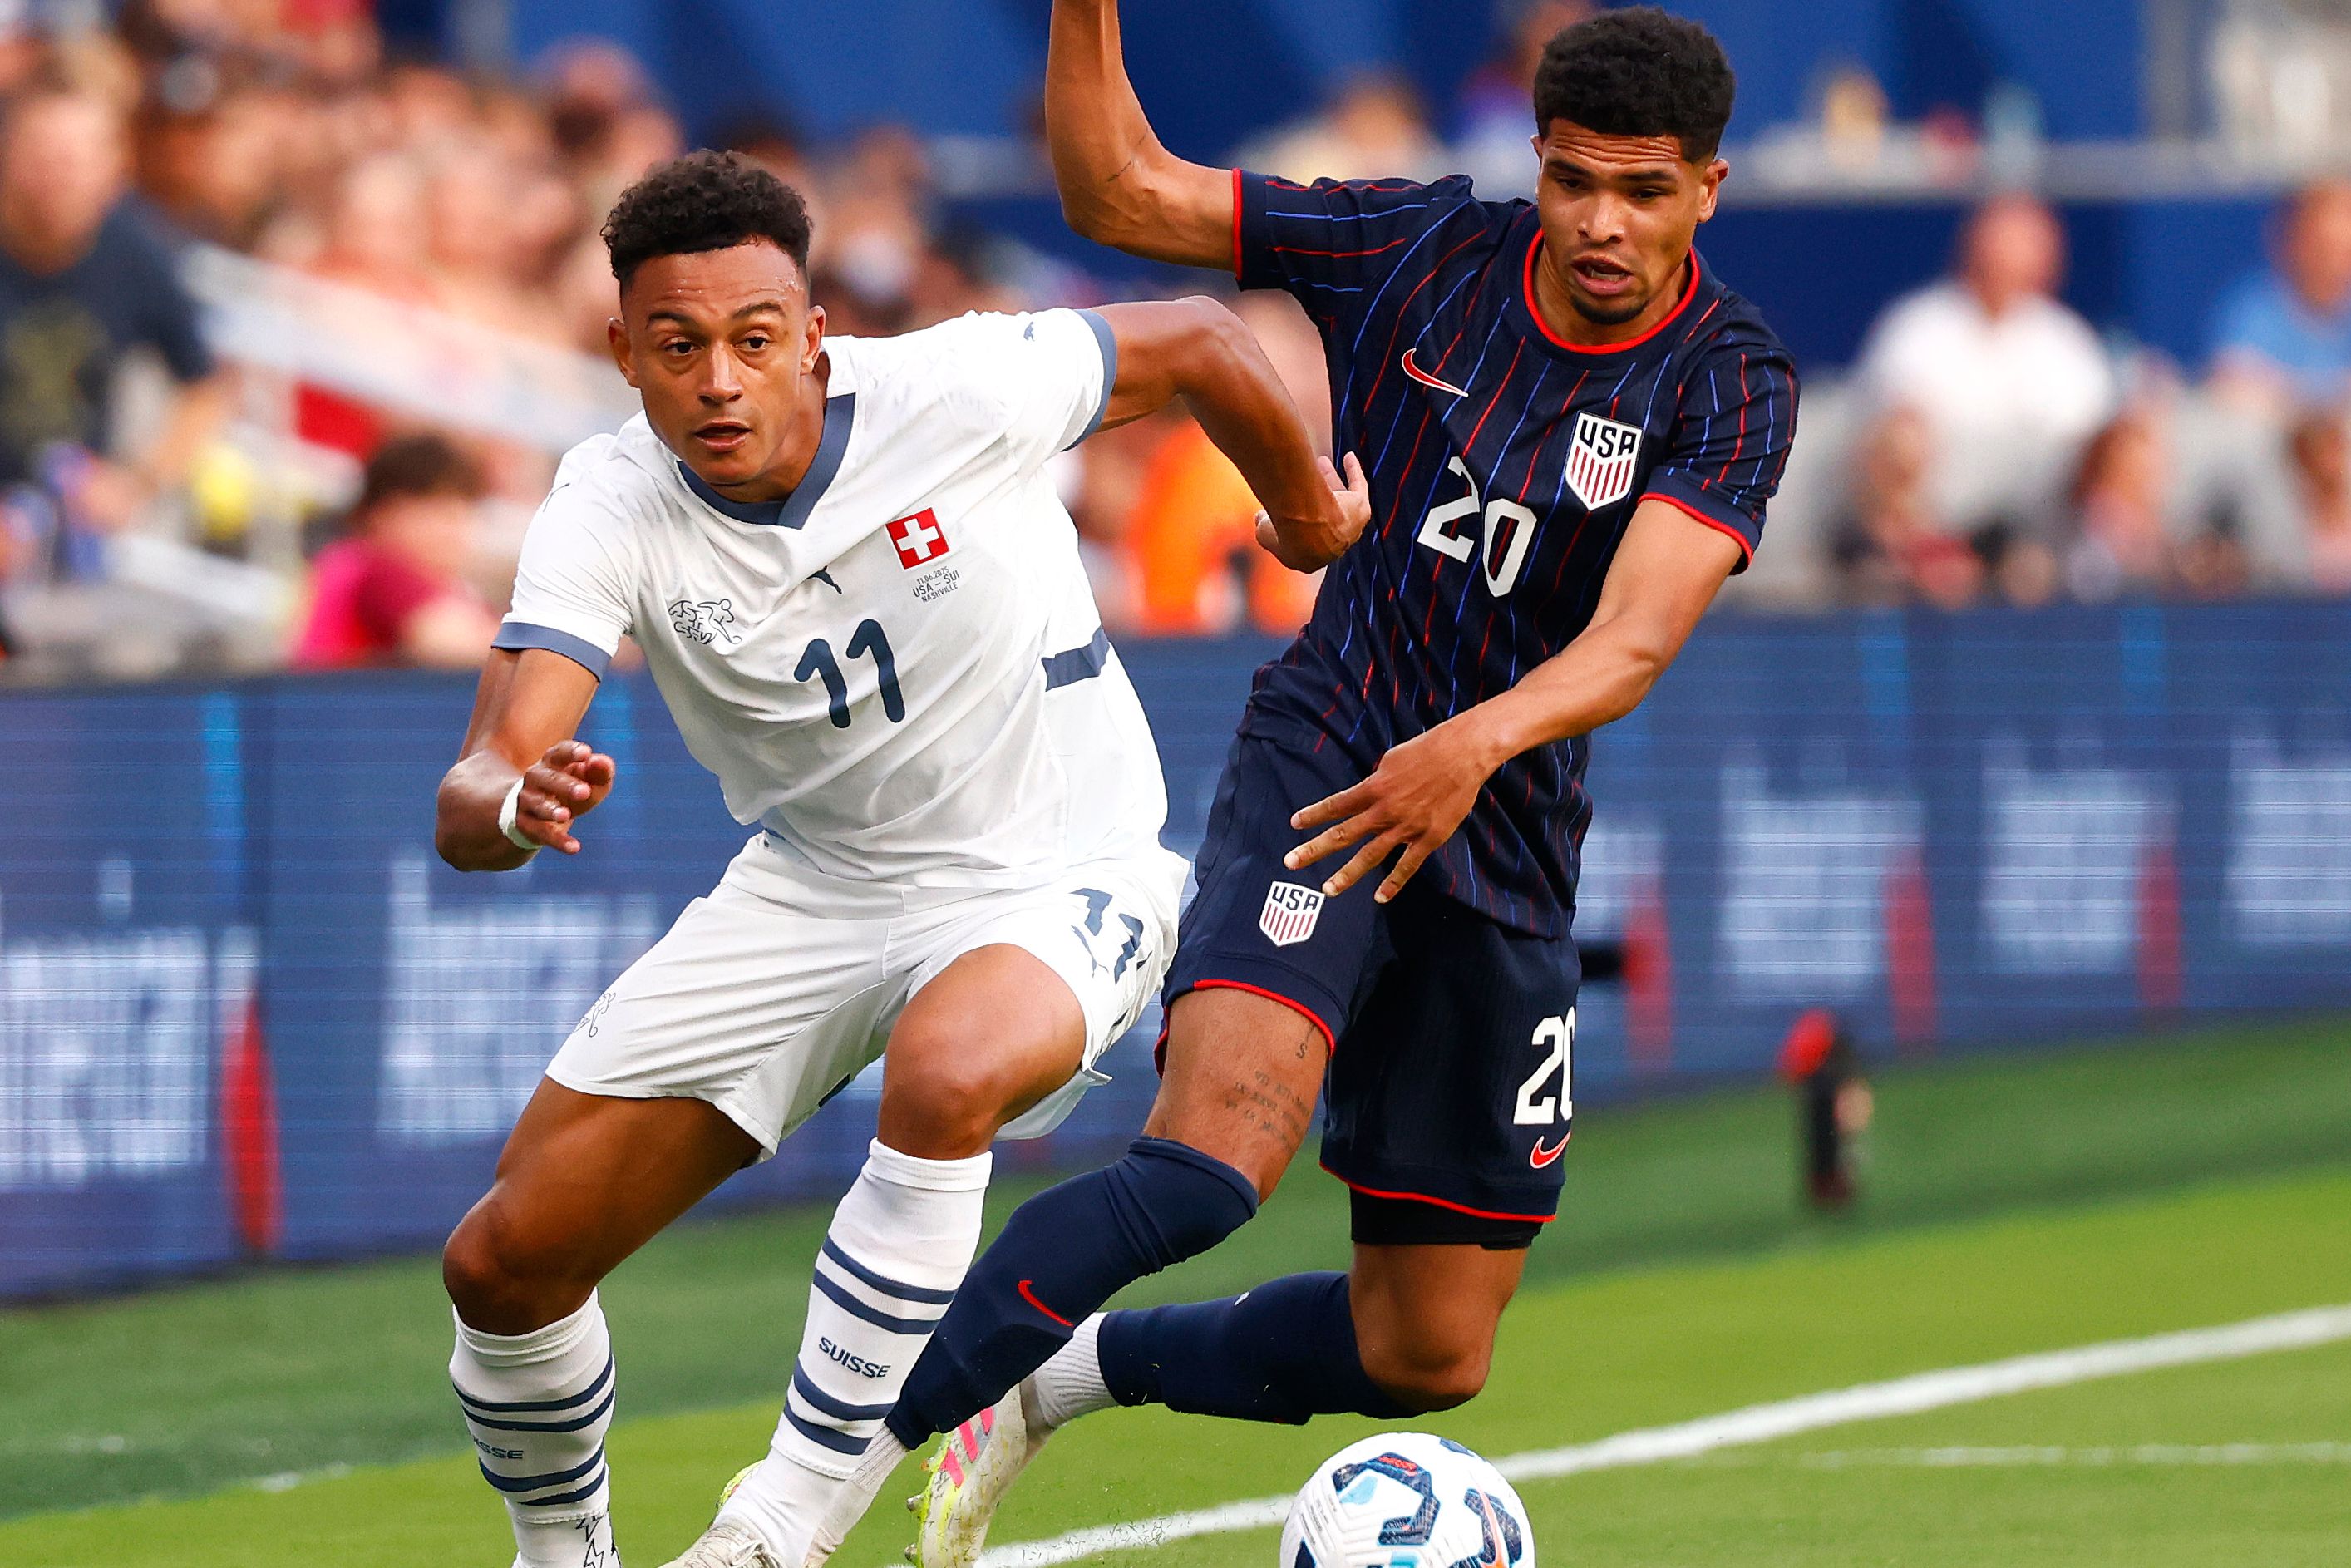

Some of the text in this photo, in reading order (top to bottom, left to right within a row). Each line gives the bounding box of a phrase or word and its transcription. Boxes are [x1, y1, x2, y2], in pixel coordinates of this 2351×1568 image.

[1579, 419, 1637, 459] USA
[1416, 456, 1538, 599] 20
[912, 582, 934, 598] USA
[943, 570, 960, 584] SUI
[921, 581, 959, 604] NASHVILLE
[794, 618, 906, 729] 11
[1271, 885, 1320, 911] USA
[818, 1335, 892, 1378] SUISSE
